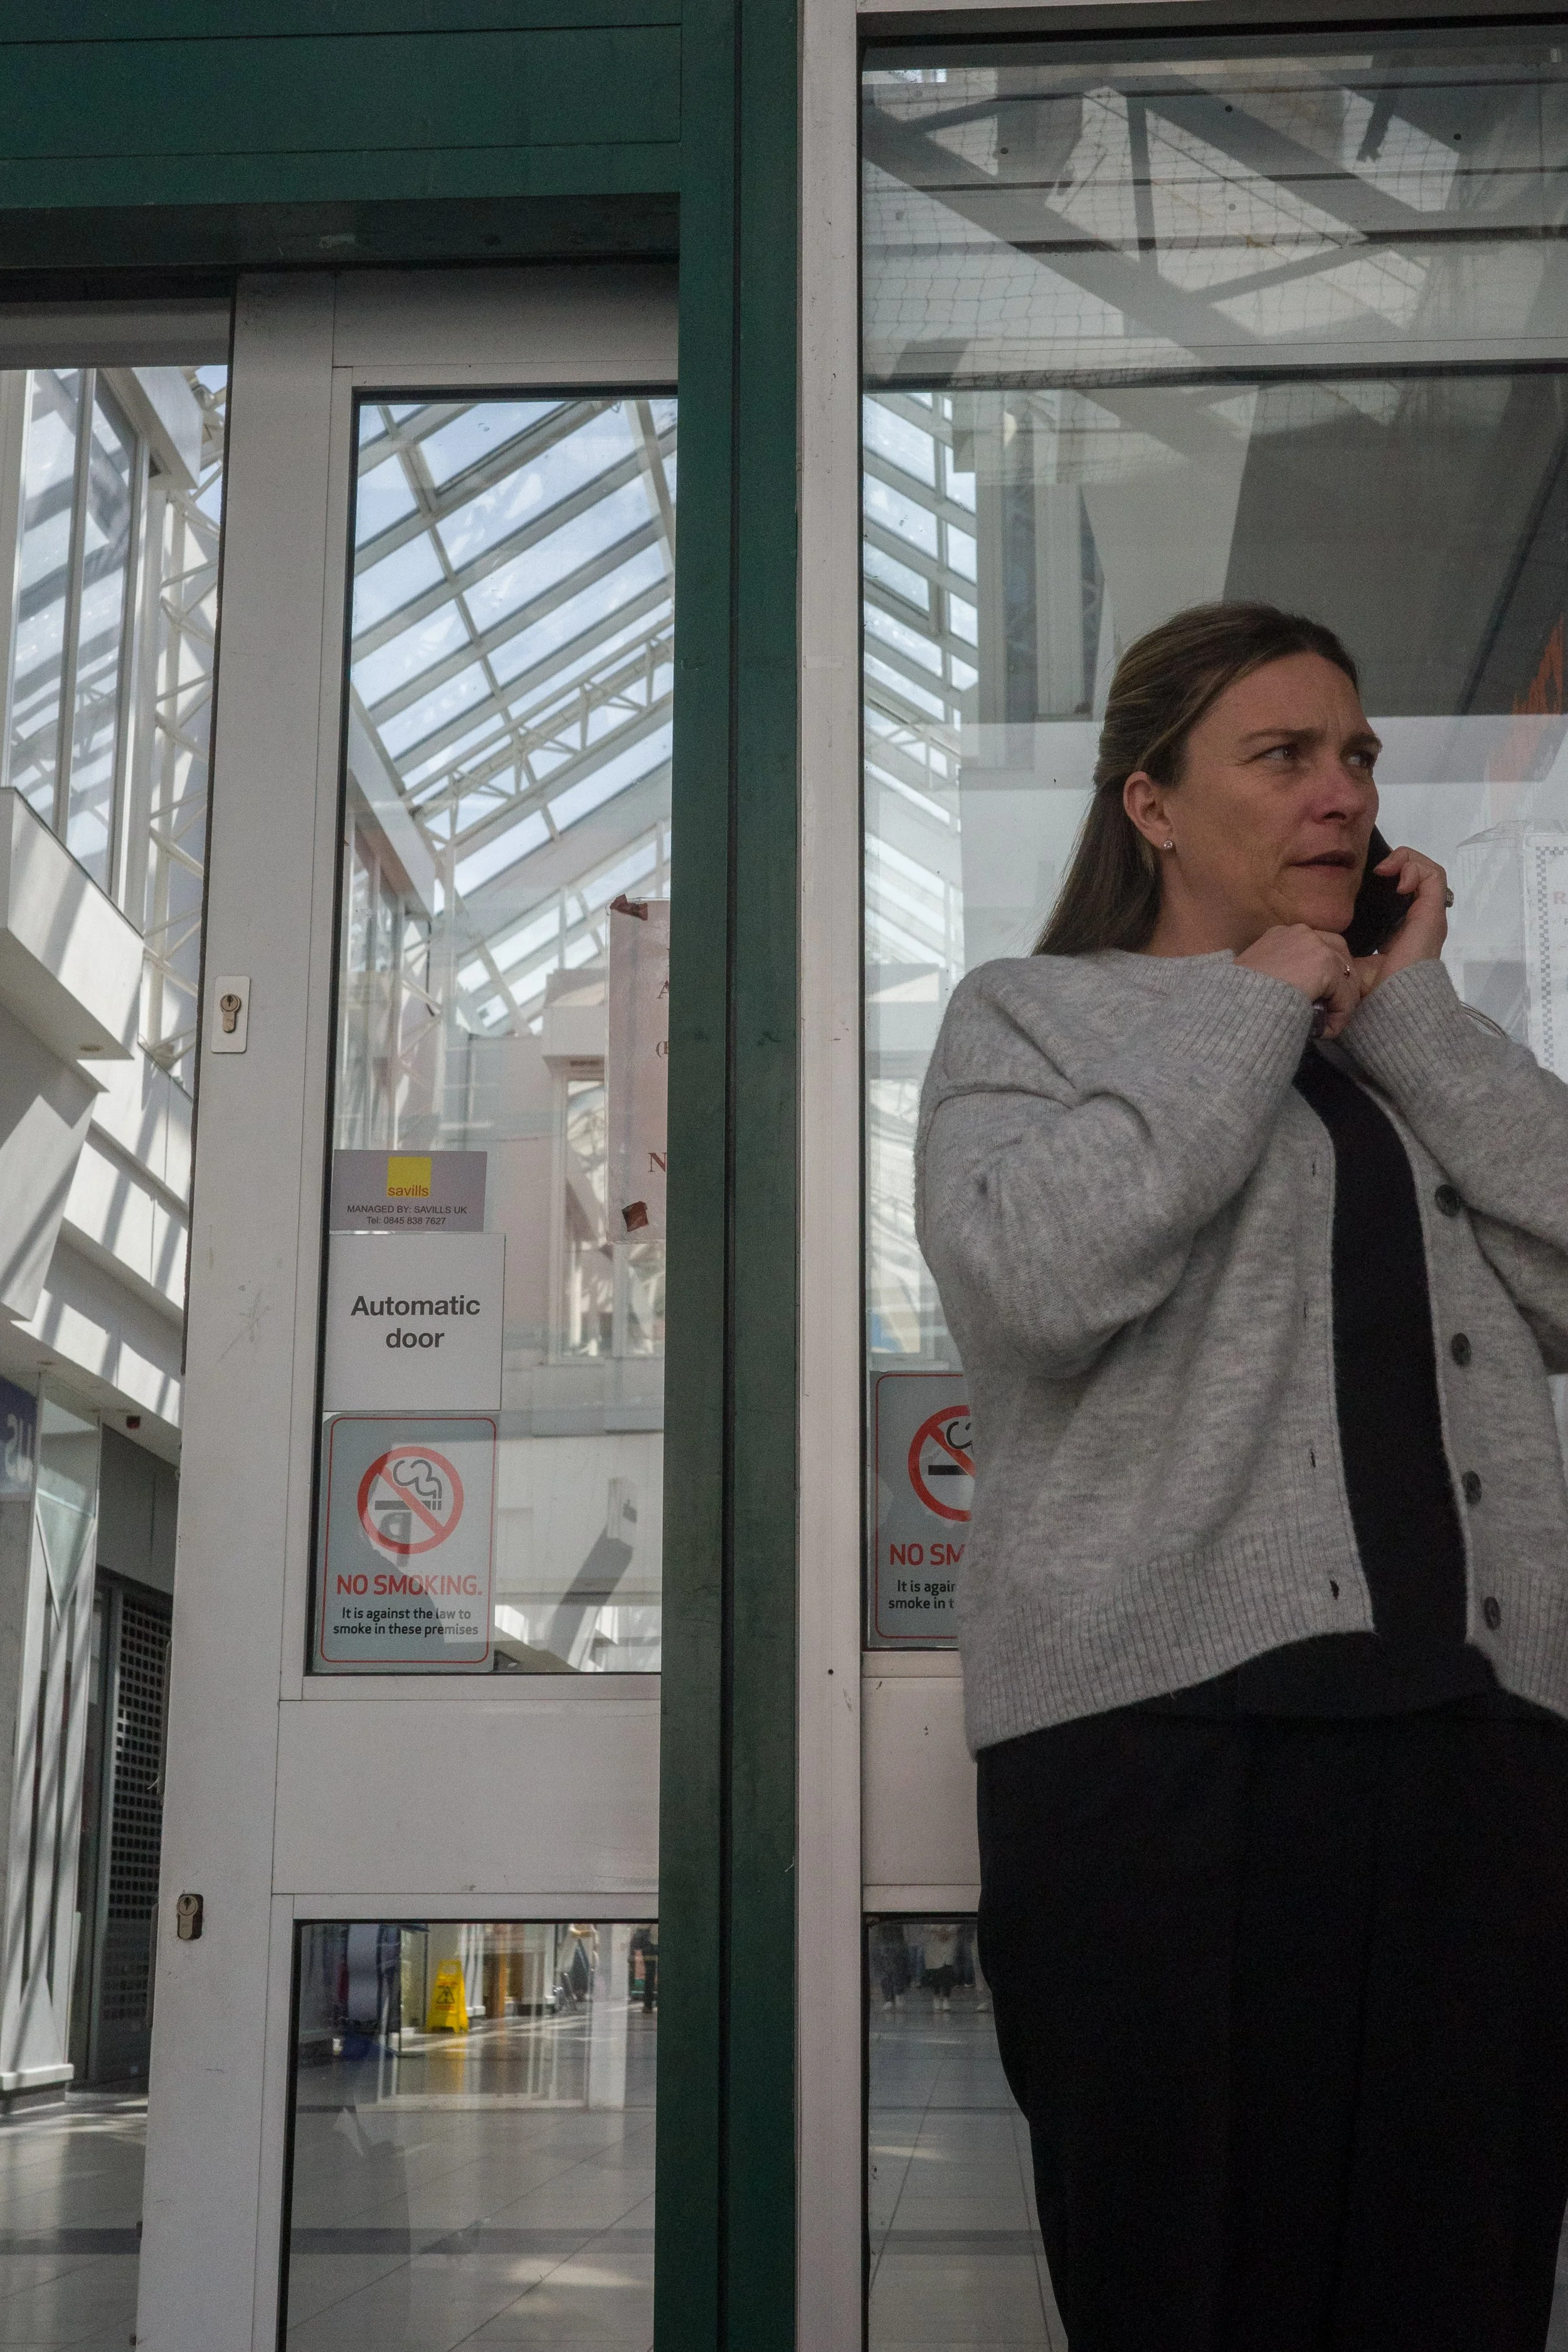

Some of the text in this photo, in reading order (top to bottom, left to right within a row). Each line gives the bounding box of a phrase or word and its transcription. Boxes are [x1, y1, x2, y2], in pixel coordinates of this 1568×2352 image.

[388, 1185, 429, 1197] savills
[347, 1205, 394, 1213] MANAGED
[351, 1295, 480, 1316] Automatic
[386, 1328, 445, 1348] door
[889, 1544, 923, 1565] NO
[337, 1574, 482, 1596] NO SMOKING.
[898, 1580, 907, 1592] It
[911, 1581, 920, 1592] is
[889, 1597, 930, 1609] smoke
[934, 1597, 945, 1609] in
[342, 1607, 471, 1621] It is against the law to
[333, 1623, 478, 1637] smoke in these premises
